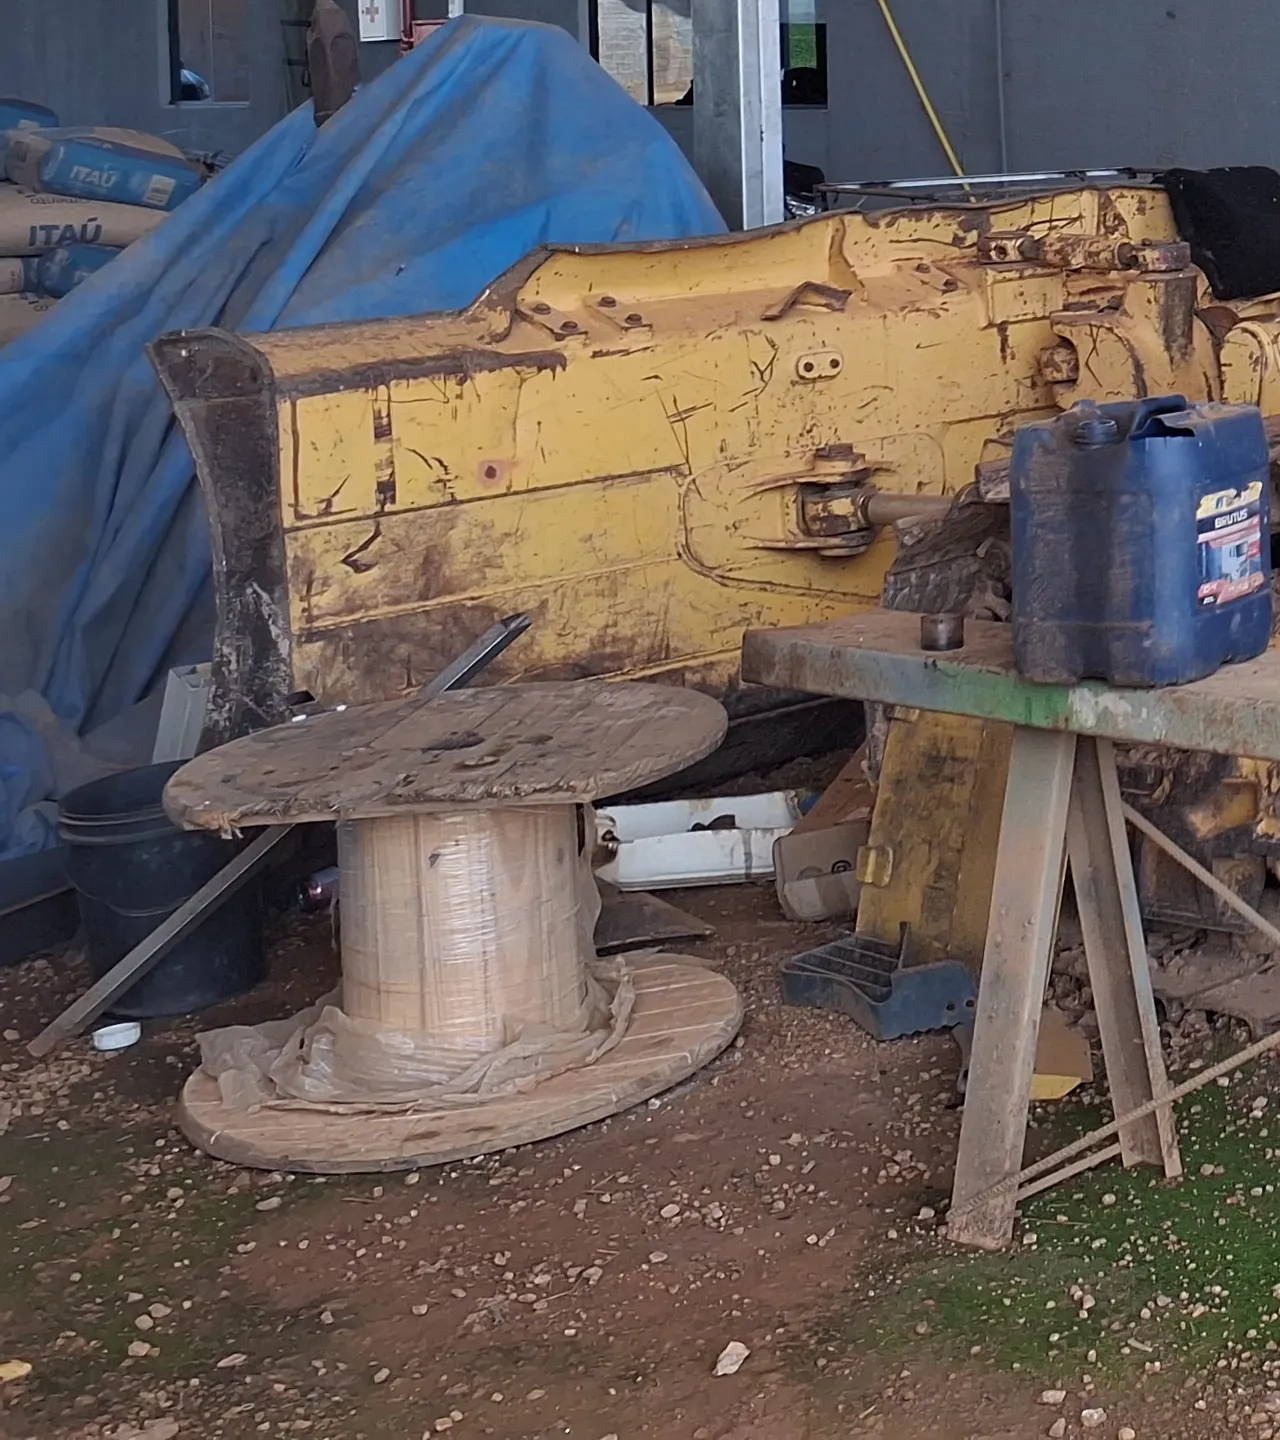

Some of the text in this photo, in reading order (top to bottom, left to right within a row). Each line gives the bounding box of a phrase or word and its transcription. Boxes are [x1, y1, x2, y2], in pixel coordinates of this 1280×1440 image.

[70, 164, 117, 187] ITAÚ
[29, 218, 102, 247] ITAÚ
[1214, 508, 1248, 529] BRUTUS
